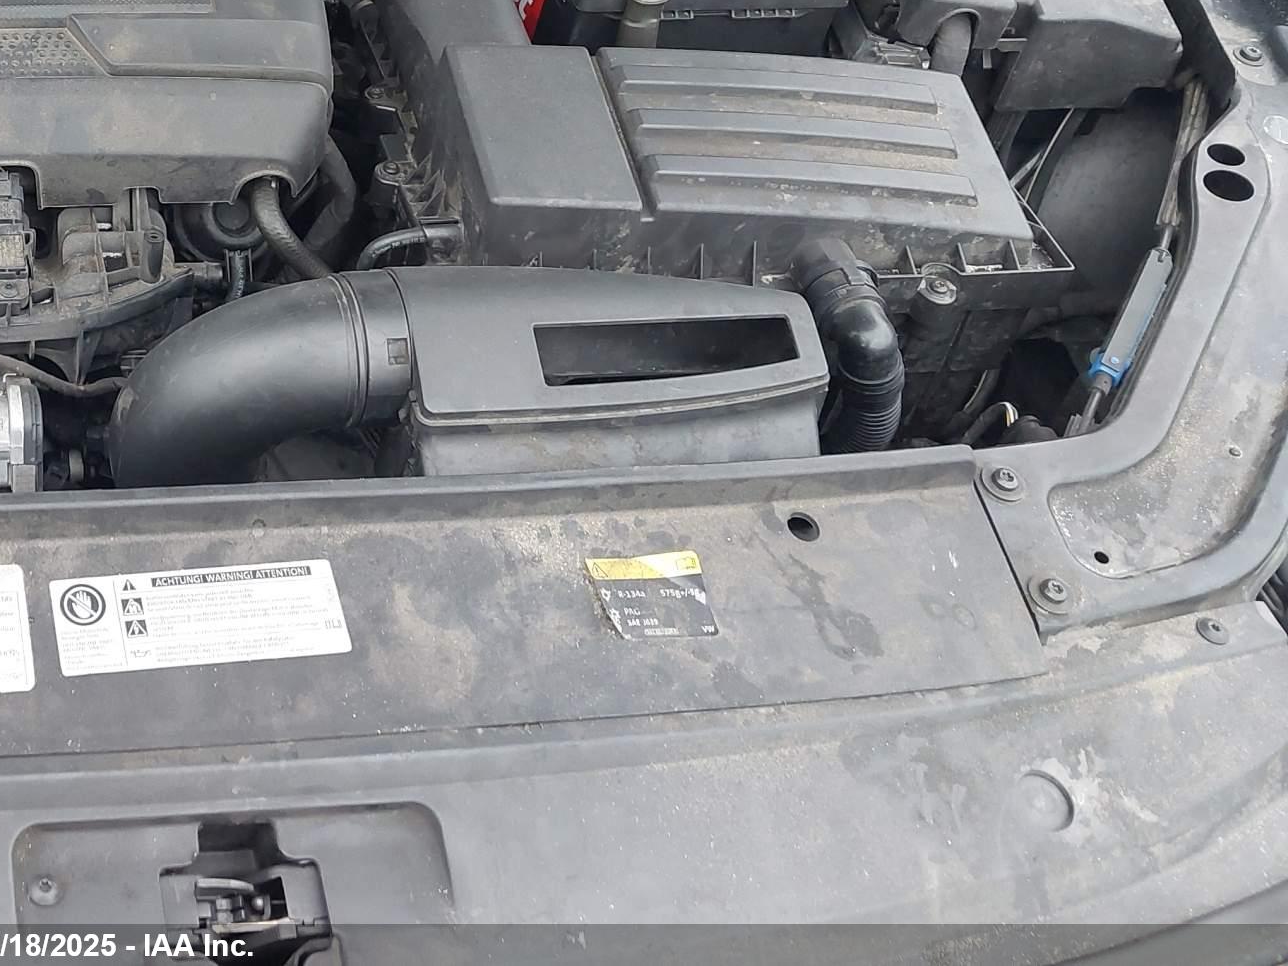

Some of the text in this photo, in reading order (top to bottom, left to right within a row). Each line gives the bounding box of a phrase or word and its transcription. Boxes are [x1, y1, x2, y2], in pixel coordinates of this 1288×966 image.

[155, 566, 308, 586] ACHTUNG! WARNING! ATTENTION!
